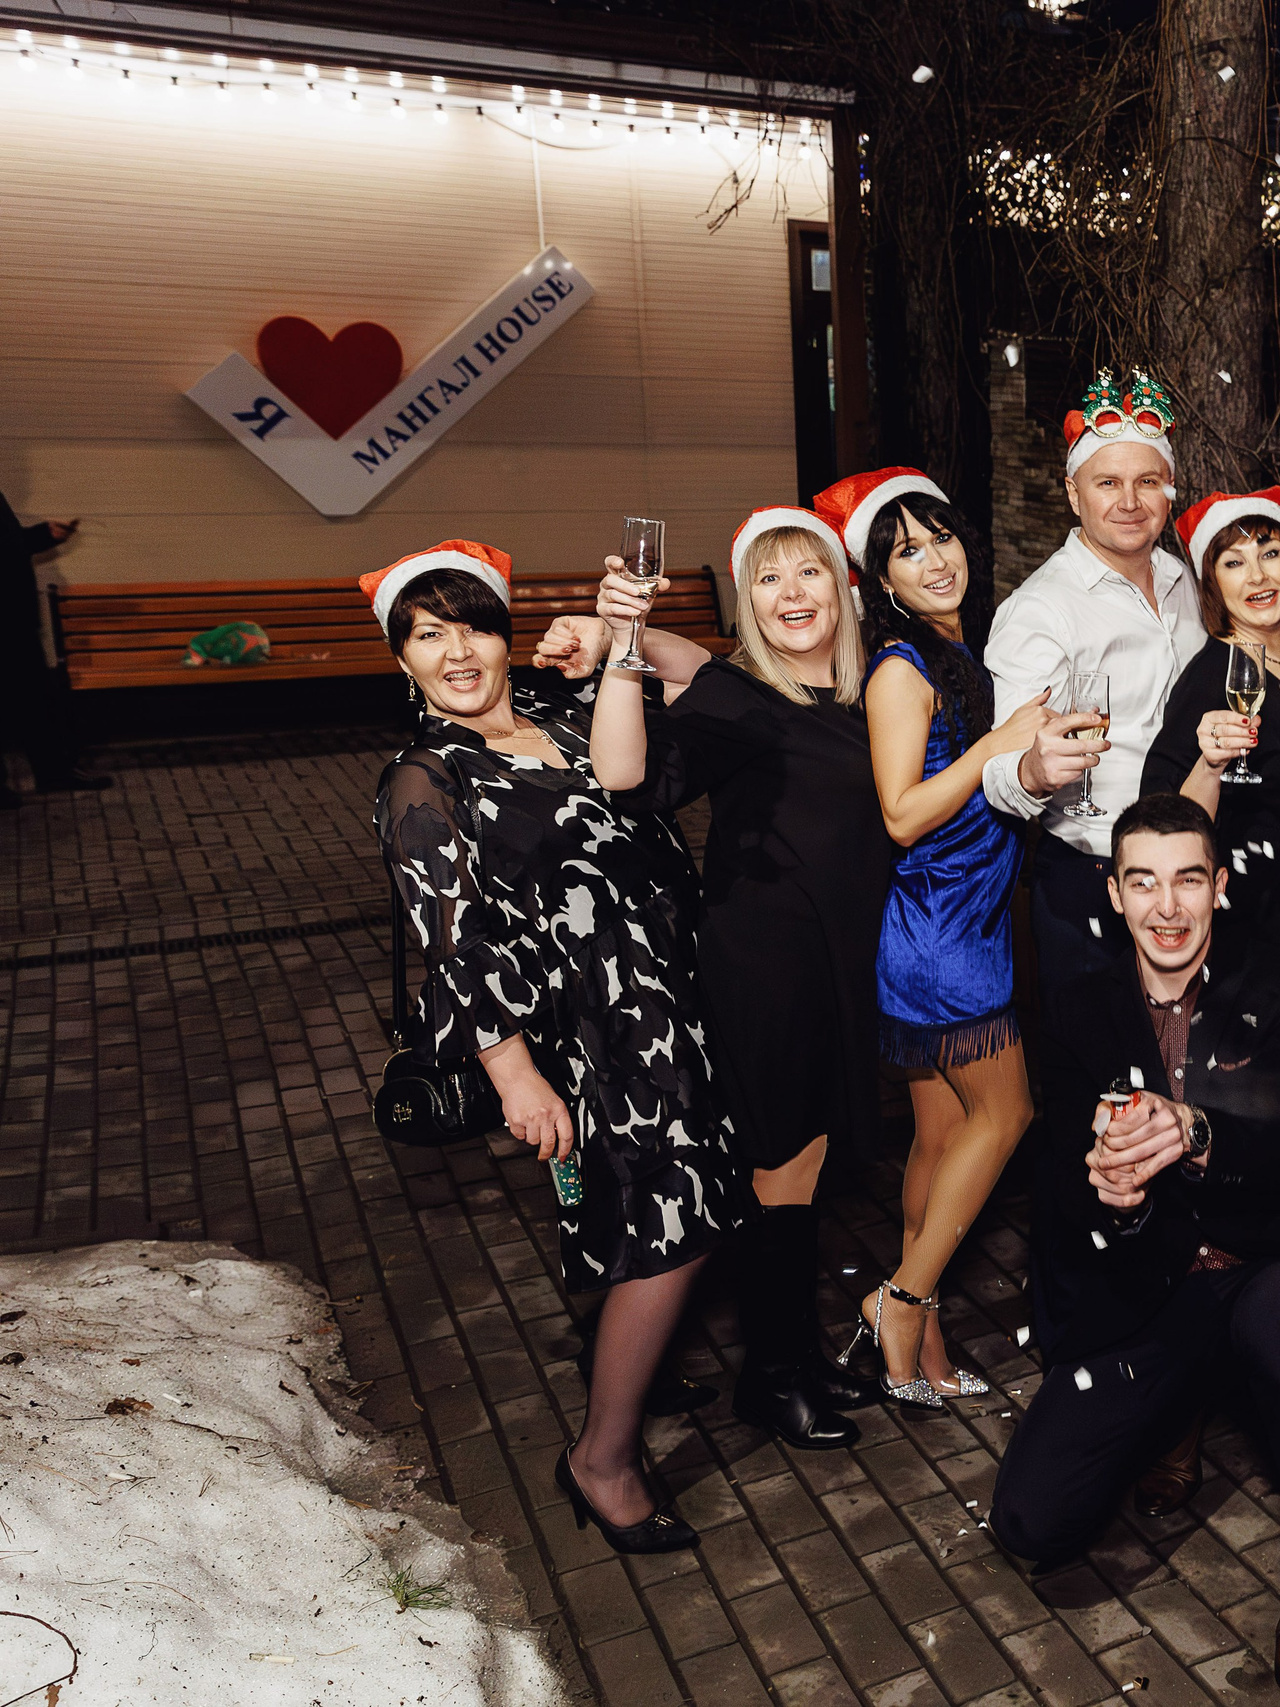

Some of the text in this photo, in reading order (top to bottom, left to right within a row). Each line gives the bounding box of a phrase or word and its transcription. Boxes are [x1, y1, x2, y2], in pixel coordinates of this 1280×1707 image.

[231, 396, 291, 441] Я
[351, 271, 575, 474] МАНГАЛ HOUSE
